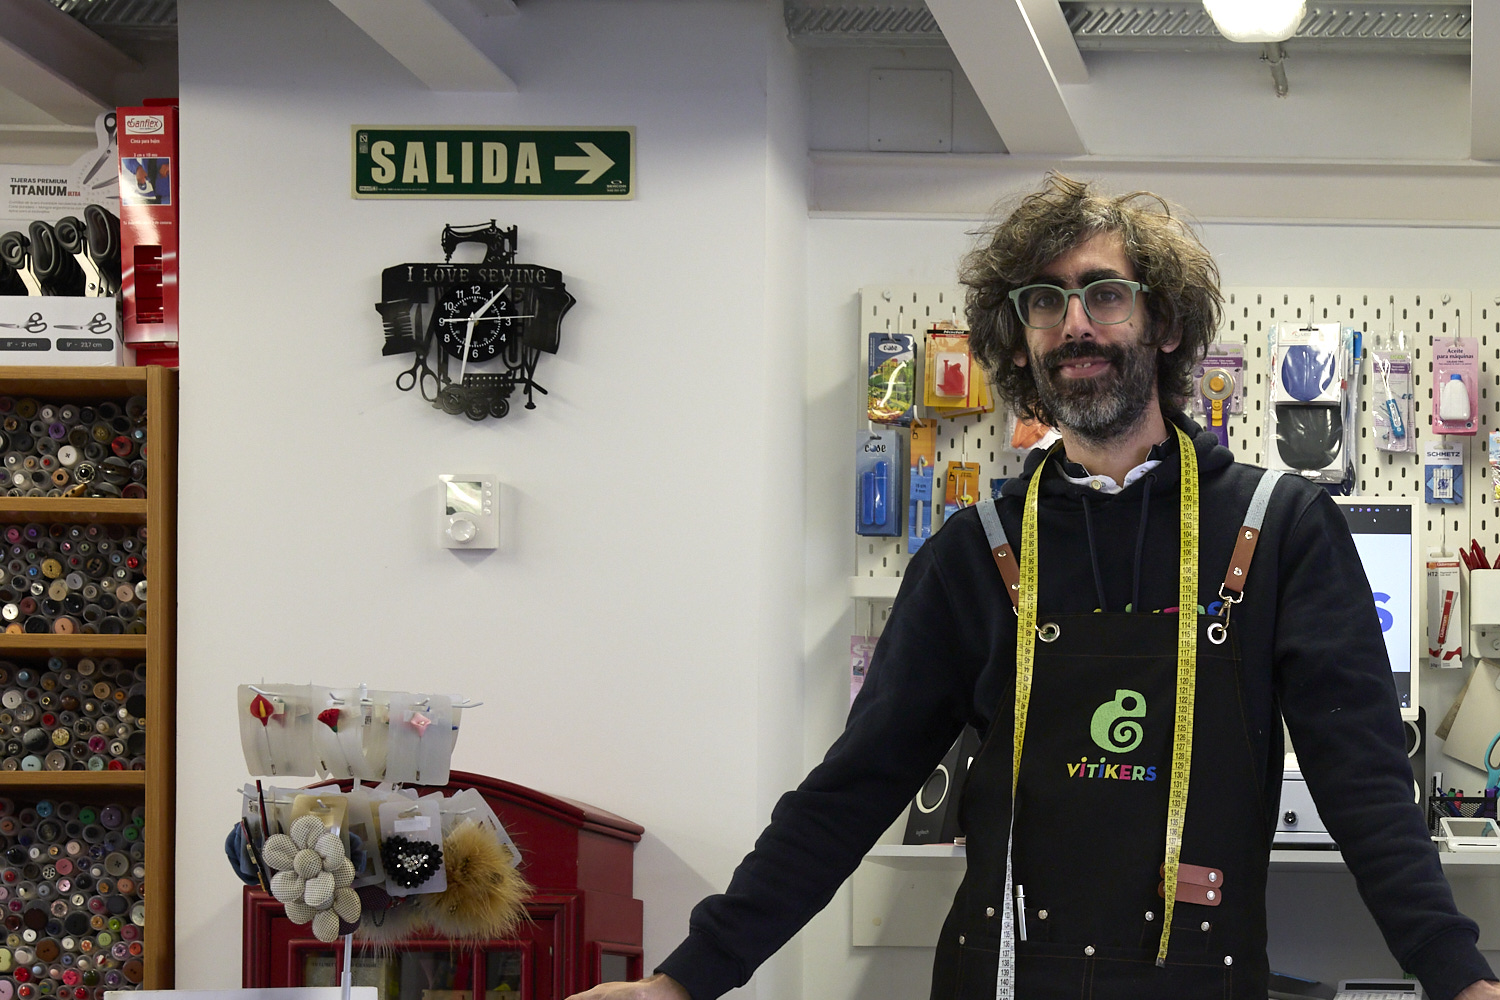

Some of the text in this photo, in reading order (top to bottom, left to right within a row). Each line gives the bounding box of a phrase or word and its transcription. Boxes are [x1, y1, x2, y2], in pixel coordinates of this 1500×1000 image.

[370, 140, 542, 184] SALIDA
[10, 184, 67, 197] TITANIUM
[408, 266, 546, 283] I LOVE SEWING
[456, 290, 464, 298] 11
[470, 286, 481, 294] 12
[444, 302, 454, 310] 10
[500, 301, 507, 310] 2
[438, 318, 445, 326] 9
[505, 317, 512, 326] 3
[444, 334, 450, 342] 8
[500, 334, 506, 342] 4
[456, 345, 462, 354] 7
[472, 349, 478, 358] 6
[488, 345, 494, 354] 5
[1066, 756, 1157, 782] VITIKERS
